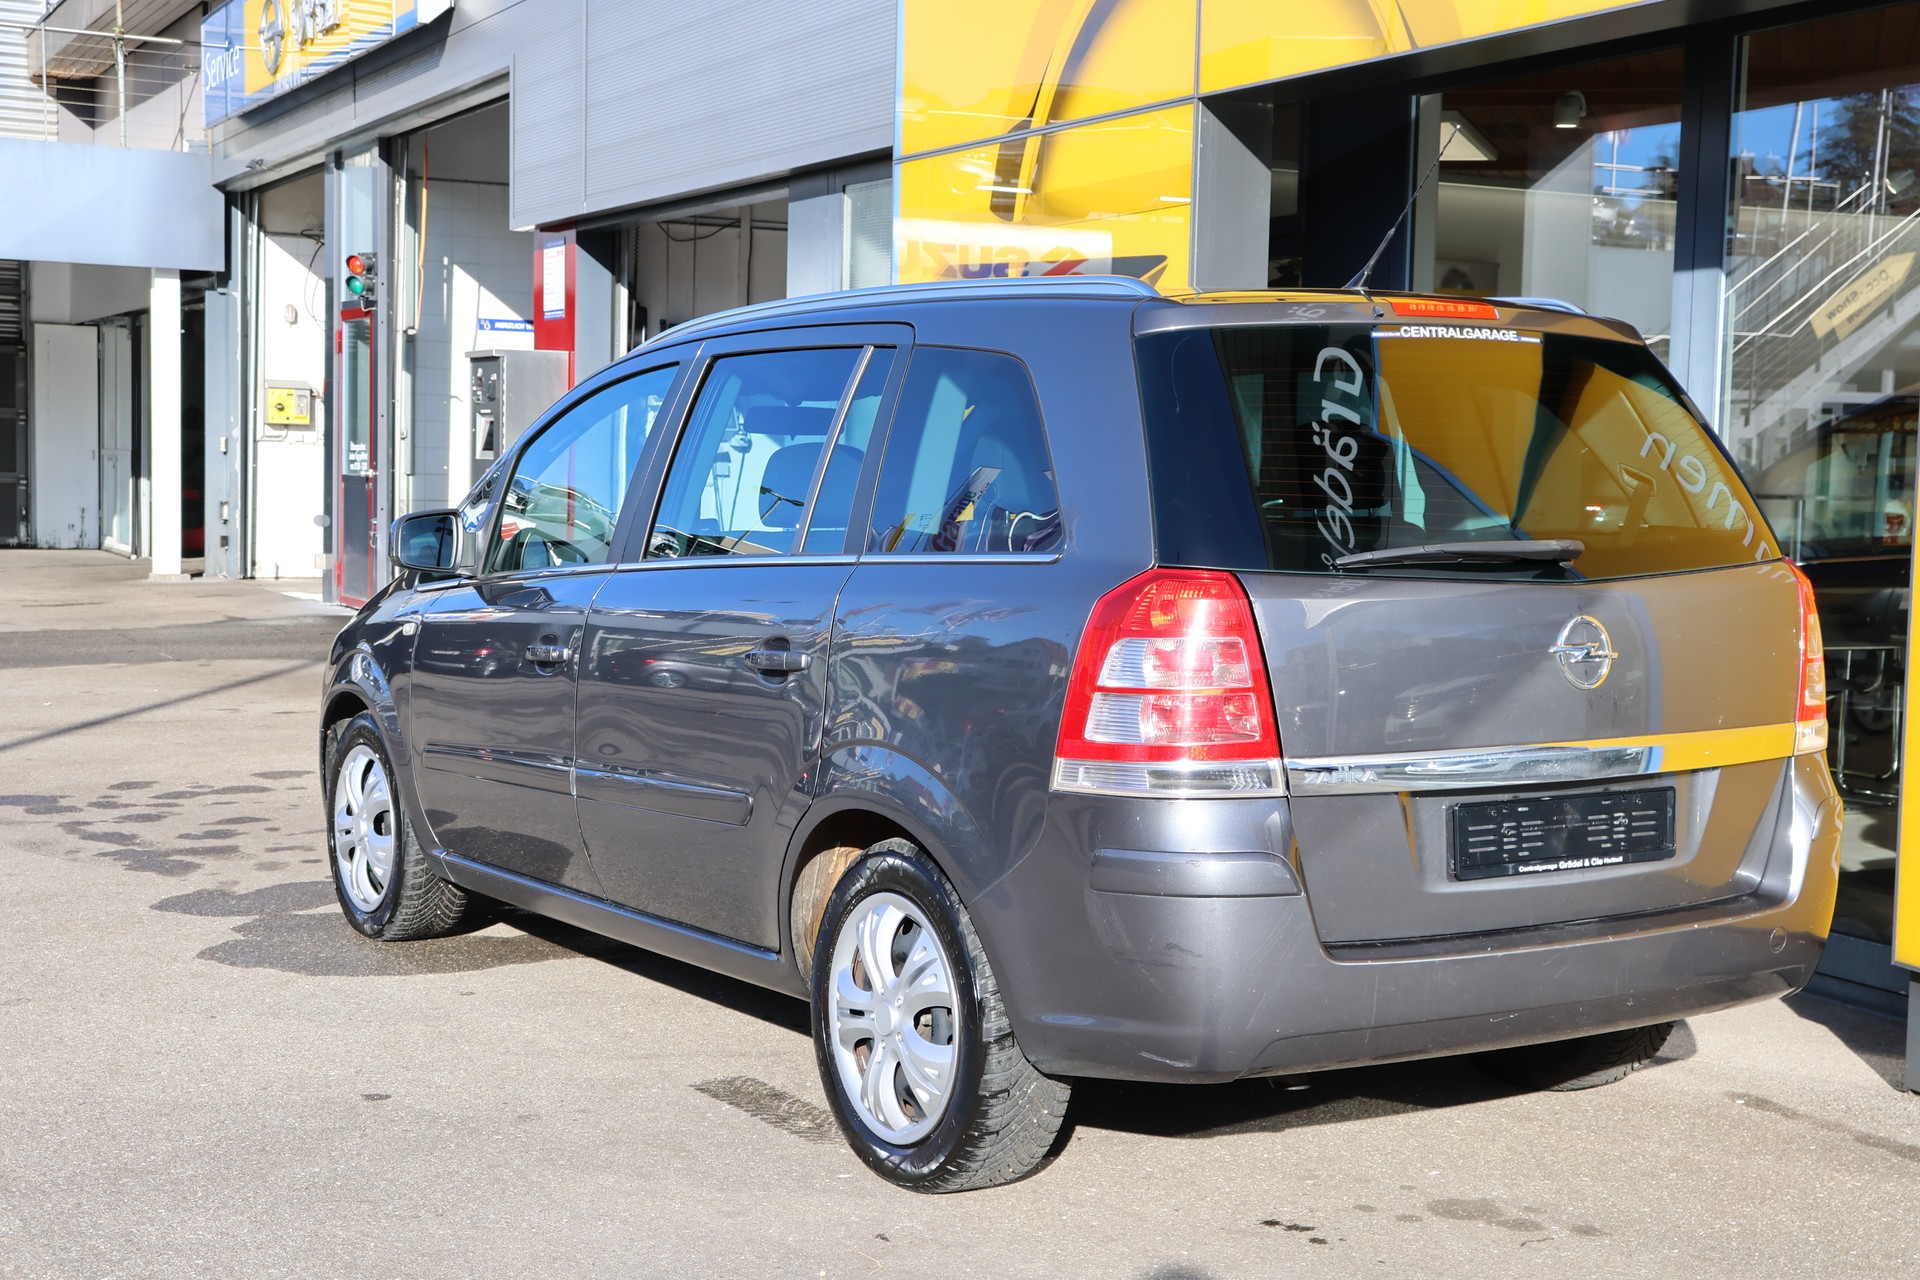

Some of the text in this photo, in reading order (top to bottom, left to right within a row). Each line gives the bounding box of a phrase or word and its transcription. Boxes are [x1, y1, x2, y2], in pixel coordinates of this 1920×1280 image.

[206, 46, 240, 91] Service
[1400, 326, 1518, 341] CENTRALGARAGE
[1303, 769, 1380, 785] ZAFIRA
[1584, 858, 1590, 867] &
